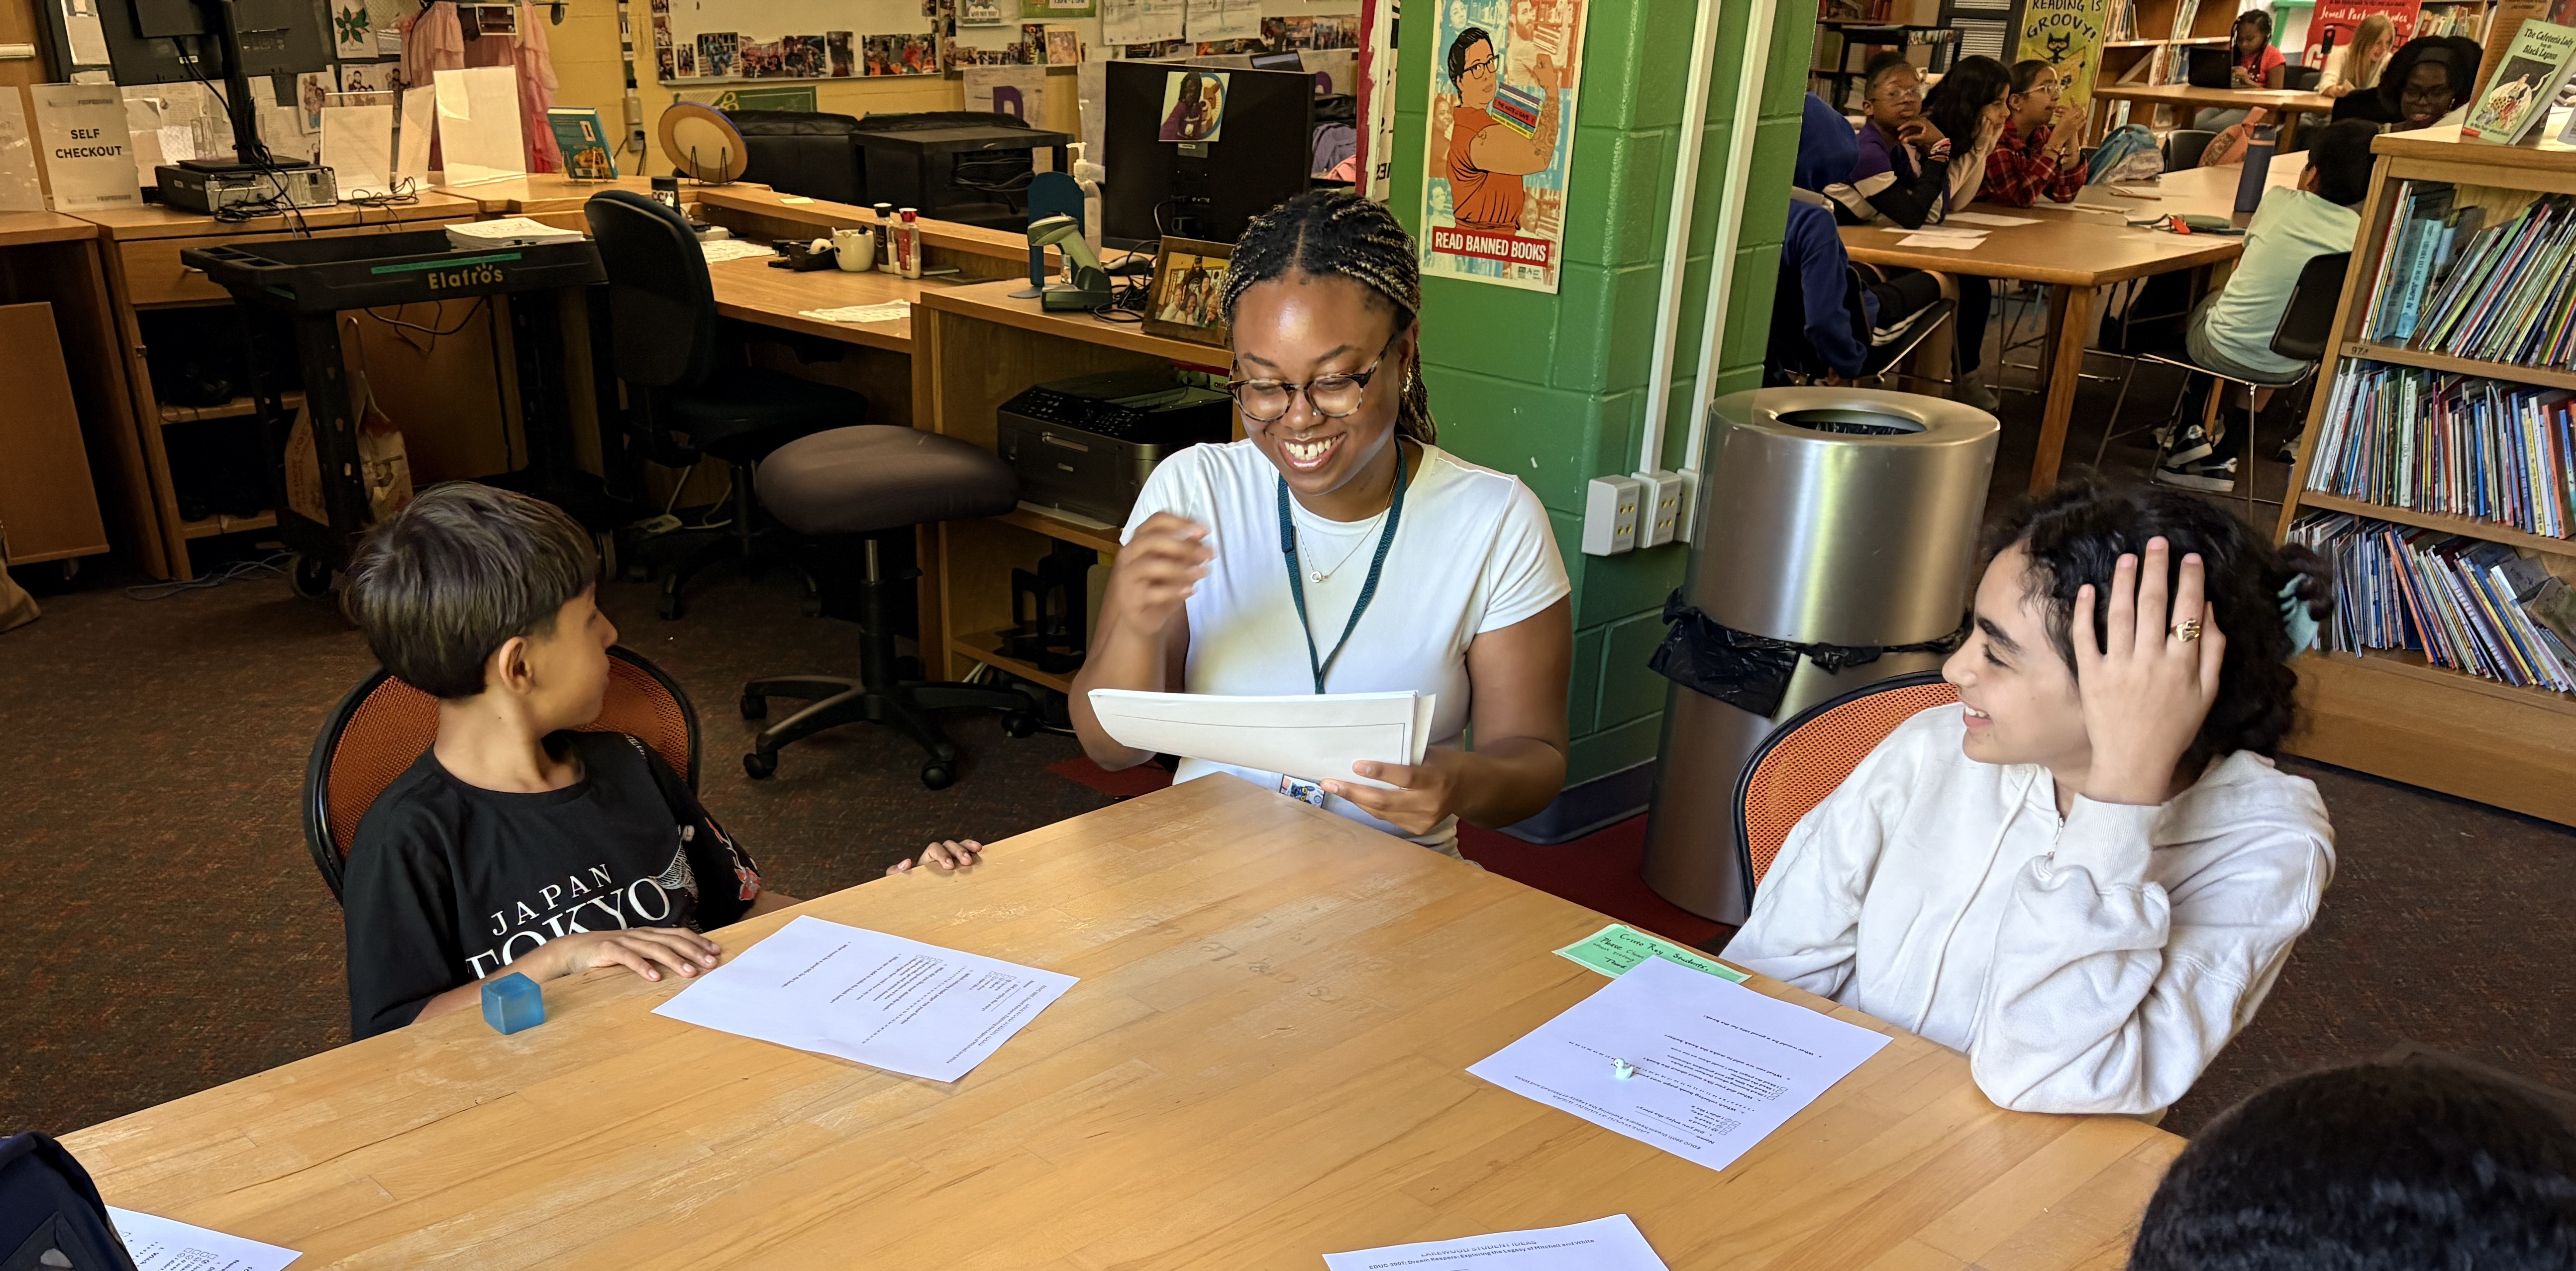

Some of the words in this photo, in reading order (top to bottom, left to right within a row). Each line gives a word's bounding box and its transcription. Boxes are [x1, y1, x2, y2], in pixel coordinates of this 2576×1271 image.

[2033, 0, 2084, 12] READING
[2091, 0, 2101, 11] IS
[2319, 6, 2345, 19] Jewell
[2027, 13, 2096, 42] GROOVY!
[2524, 28, 2536, 38] The
[2536, 31, 2561, 44] Cafeteria
[2561, 36, 2574, 49] Lady
[2523, 45, 2539, 56] Black
[2539, 48, 2558, 60] Lagoon
[71, 128, 100, 139] SELF
[56, 146, 122, 159] CHECKOUT
[1435, 231, 1463, 250] READ
[1465, 235, 1509, 256] BANNED
[1511, 241, 1546, 262] BOOKS
[491, 863, 613, 936] JAPAN
[1600, 937, 1622, 951] Please
[1620, 934, 1644, 947] Cristo
[1647, 943, 1663, 955] Rey
